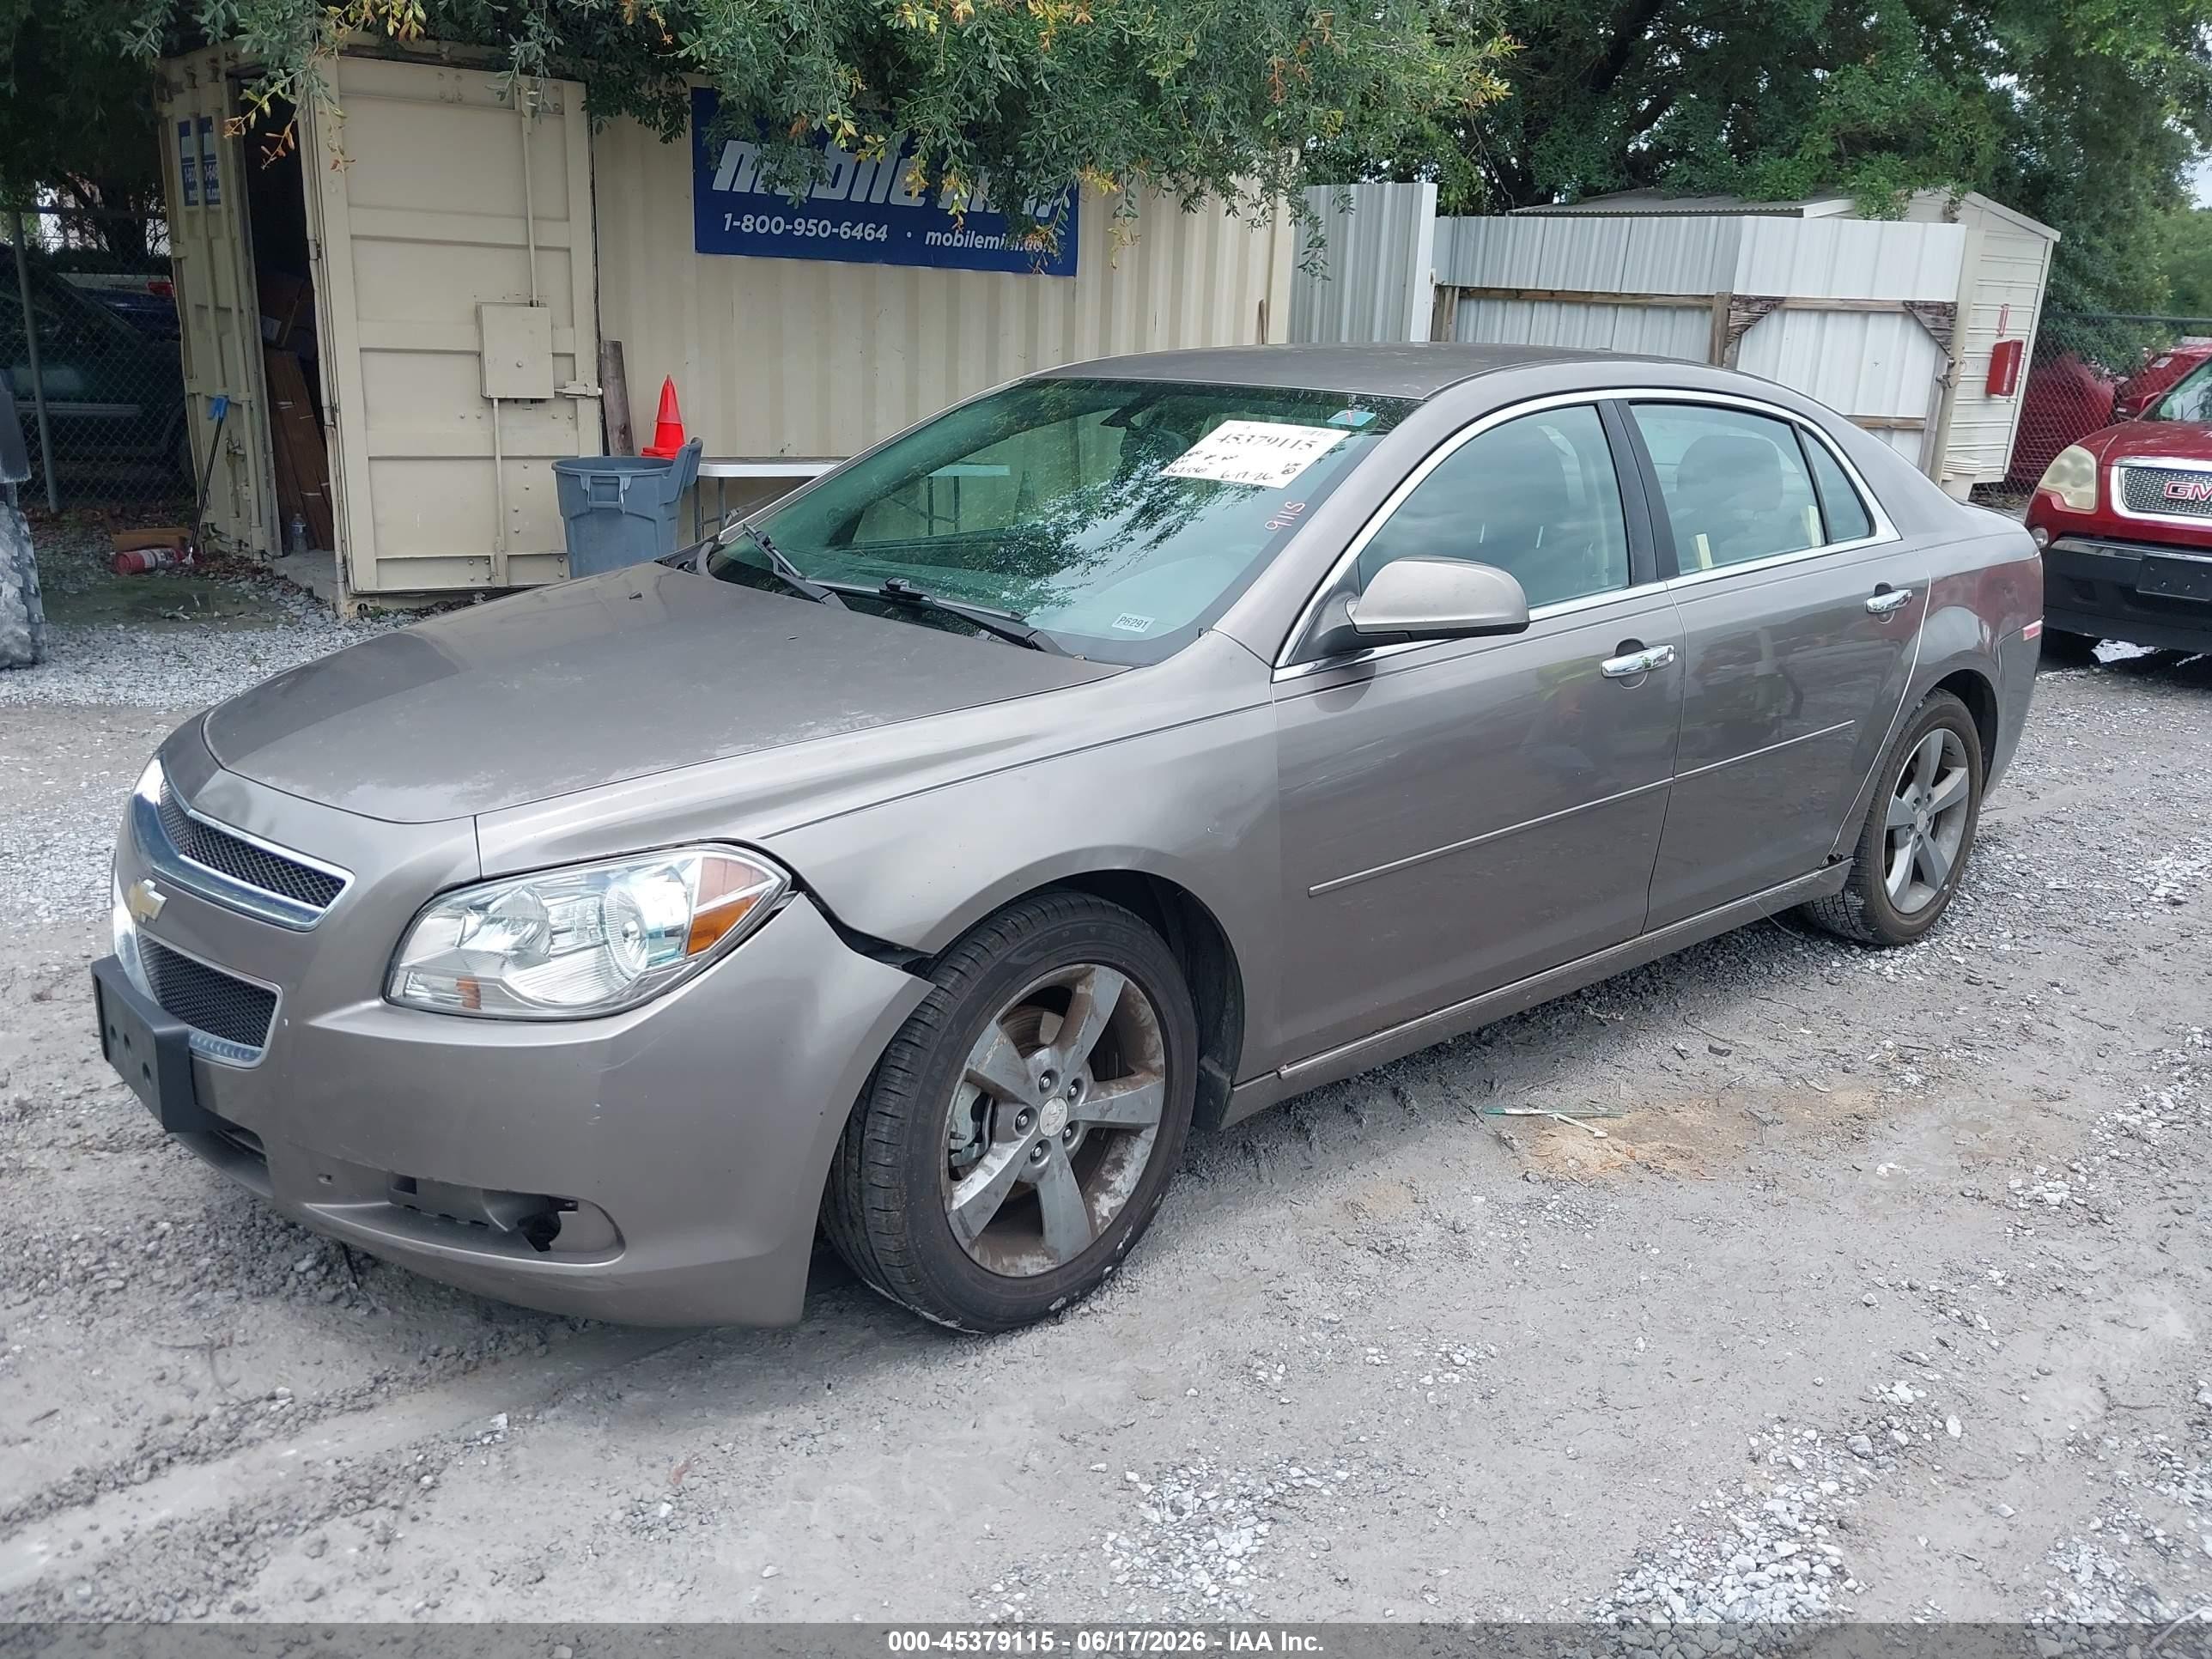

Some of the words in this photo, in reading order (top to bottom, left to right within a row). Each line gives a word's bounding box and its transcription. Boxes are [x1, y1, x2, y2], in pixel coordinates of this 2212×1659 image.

[712, 140, 927, 207] mbile
[724, 212, 888, 242] 1-800-950-6464
[2164, 481, 2212, 501] GM
[1117, 617, 1148, 629] P6291
